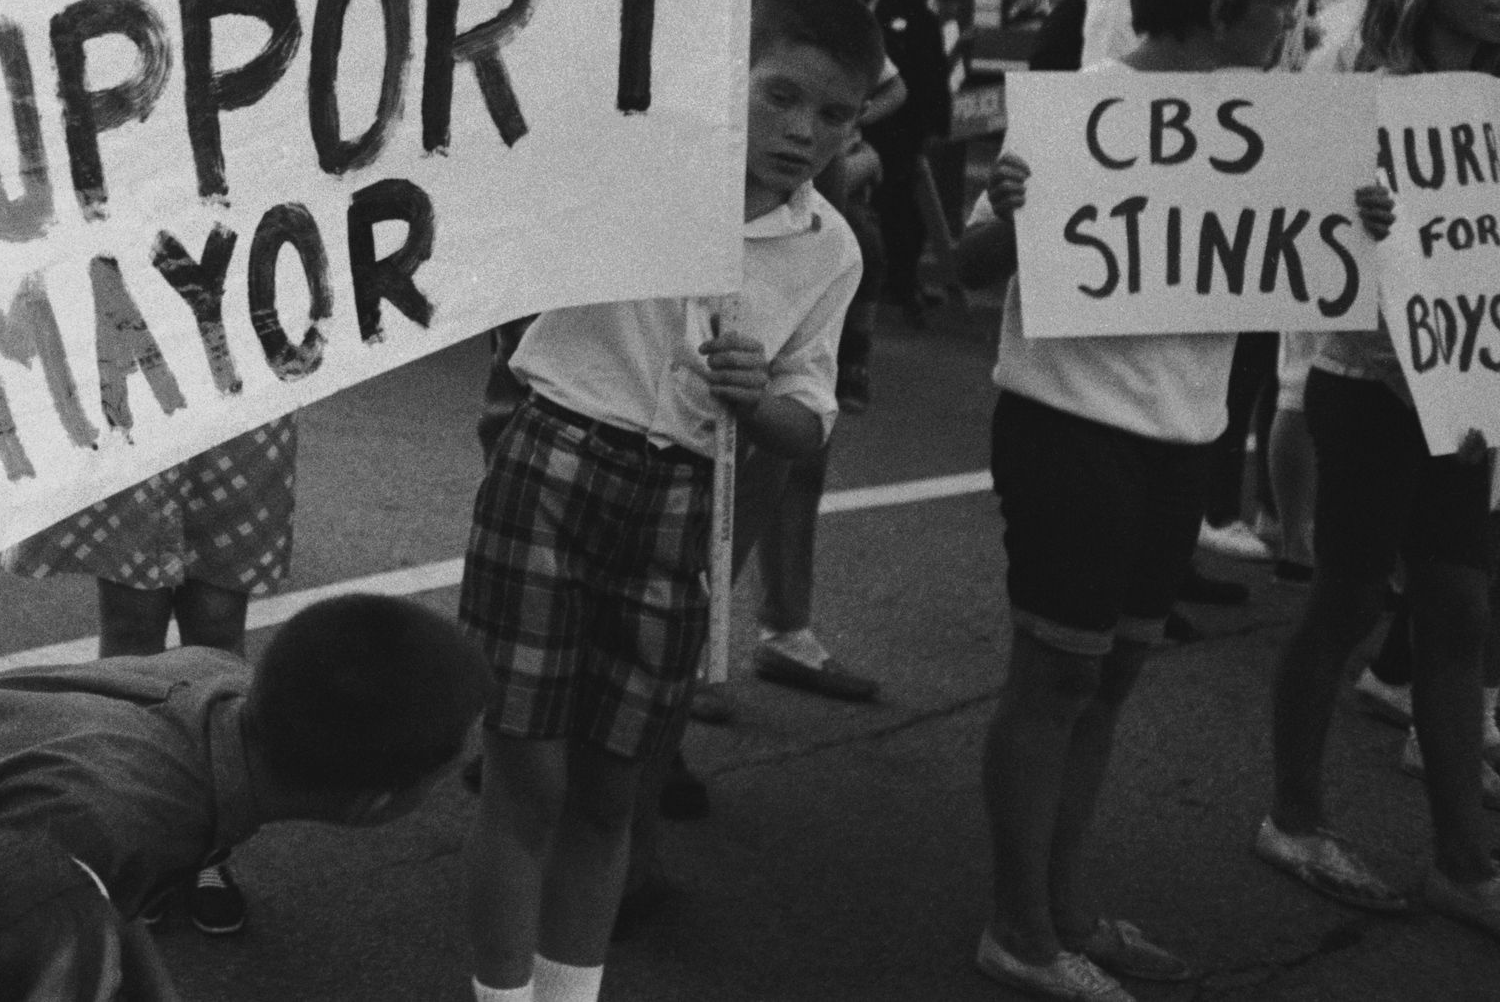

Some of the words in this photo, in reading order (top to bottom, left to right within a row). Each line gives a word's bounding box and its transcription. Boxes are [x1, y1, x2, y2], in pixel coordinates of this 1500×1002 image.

[1086, 97, 1265, 174] CBS
[1063, 196, 1361, 318] STINKS
[1418, 213, 1500, 259] FOR
